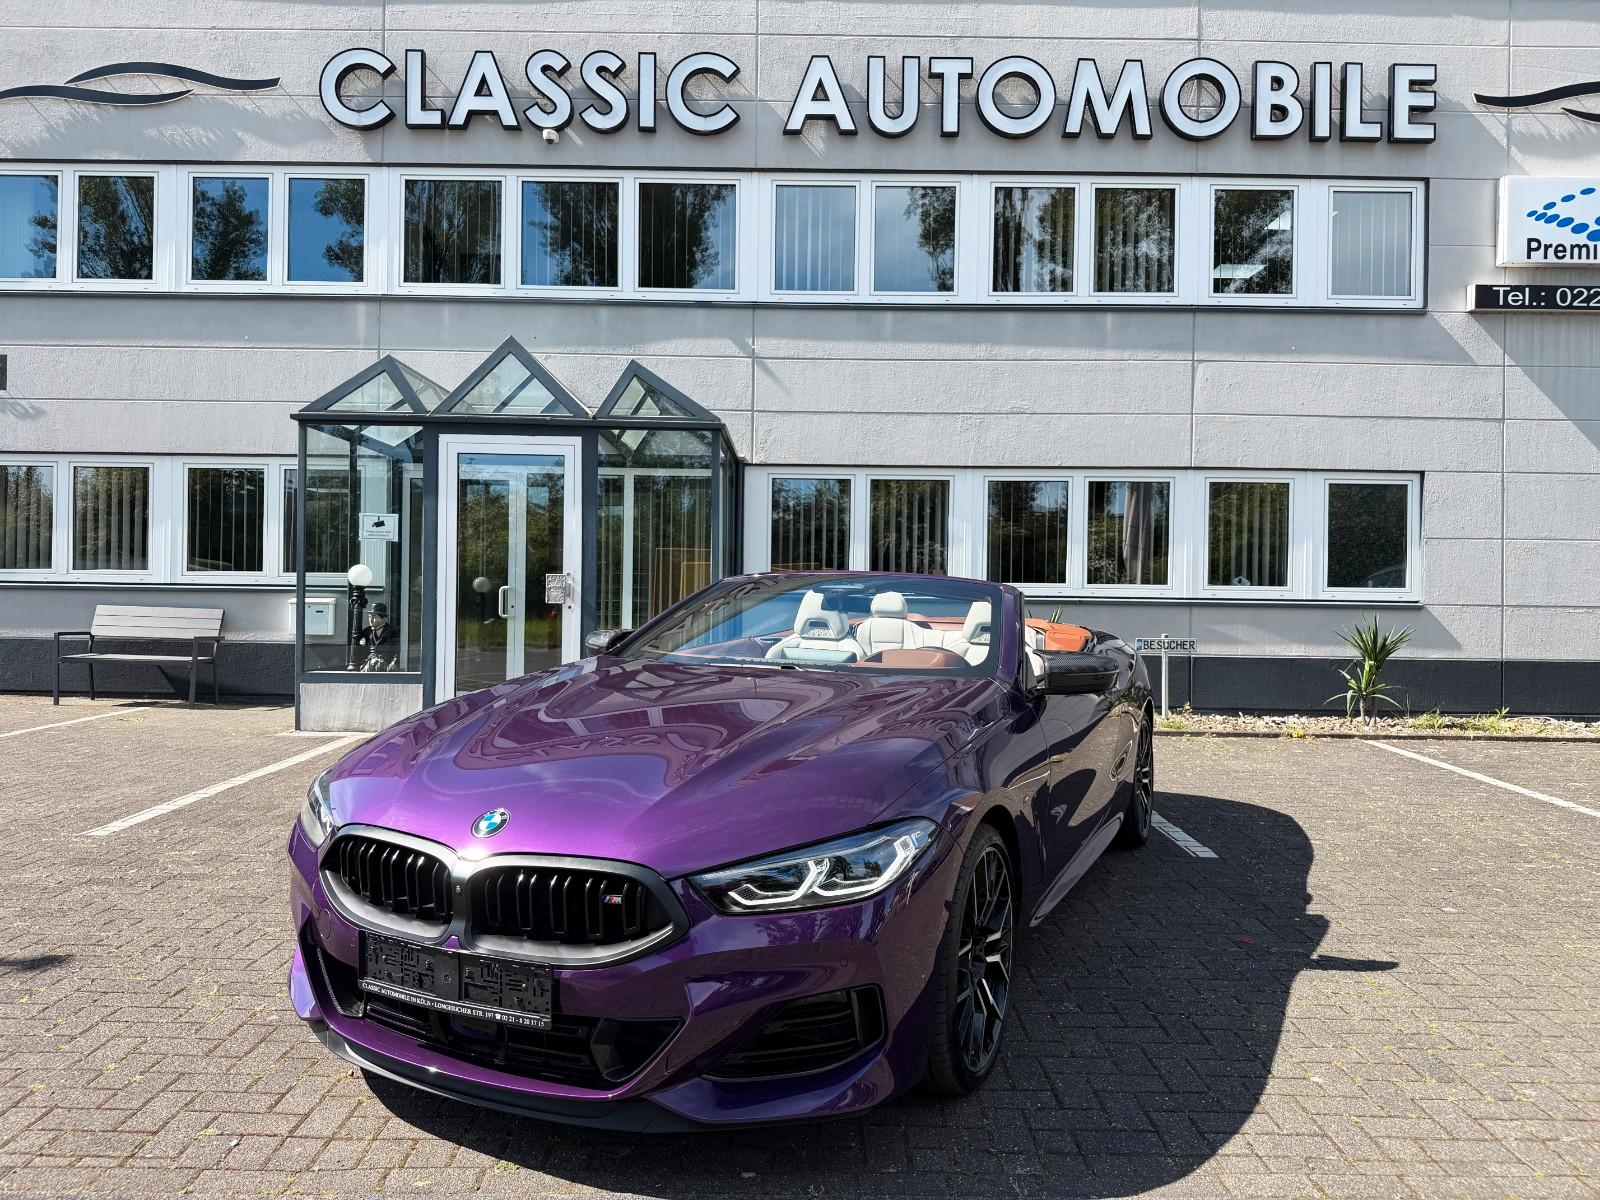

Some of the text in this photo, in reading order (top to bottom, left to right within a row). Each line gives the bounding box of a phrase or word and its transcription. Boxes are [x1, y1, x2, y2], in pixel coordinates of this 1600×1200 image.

[319, 47, 1438, 146] CLASSIC AUTOMOBILE
[1492, 286, 1546, 306] Tel.:
[1143, 640, 1196, 650] BESUCHER
[362, 982, 381, 993] CLASSIC
[381, 988, 411, 1002] AUTOMOBILE
[434, 1001, 472, 1015] LONGERICHER
